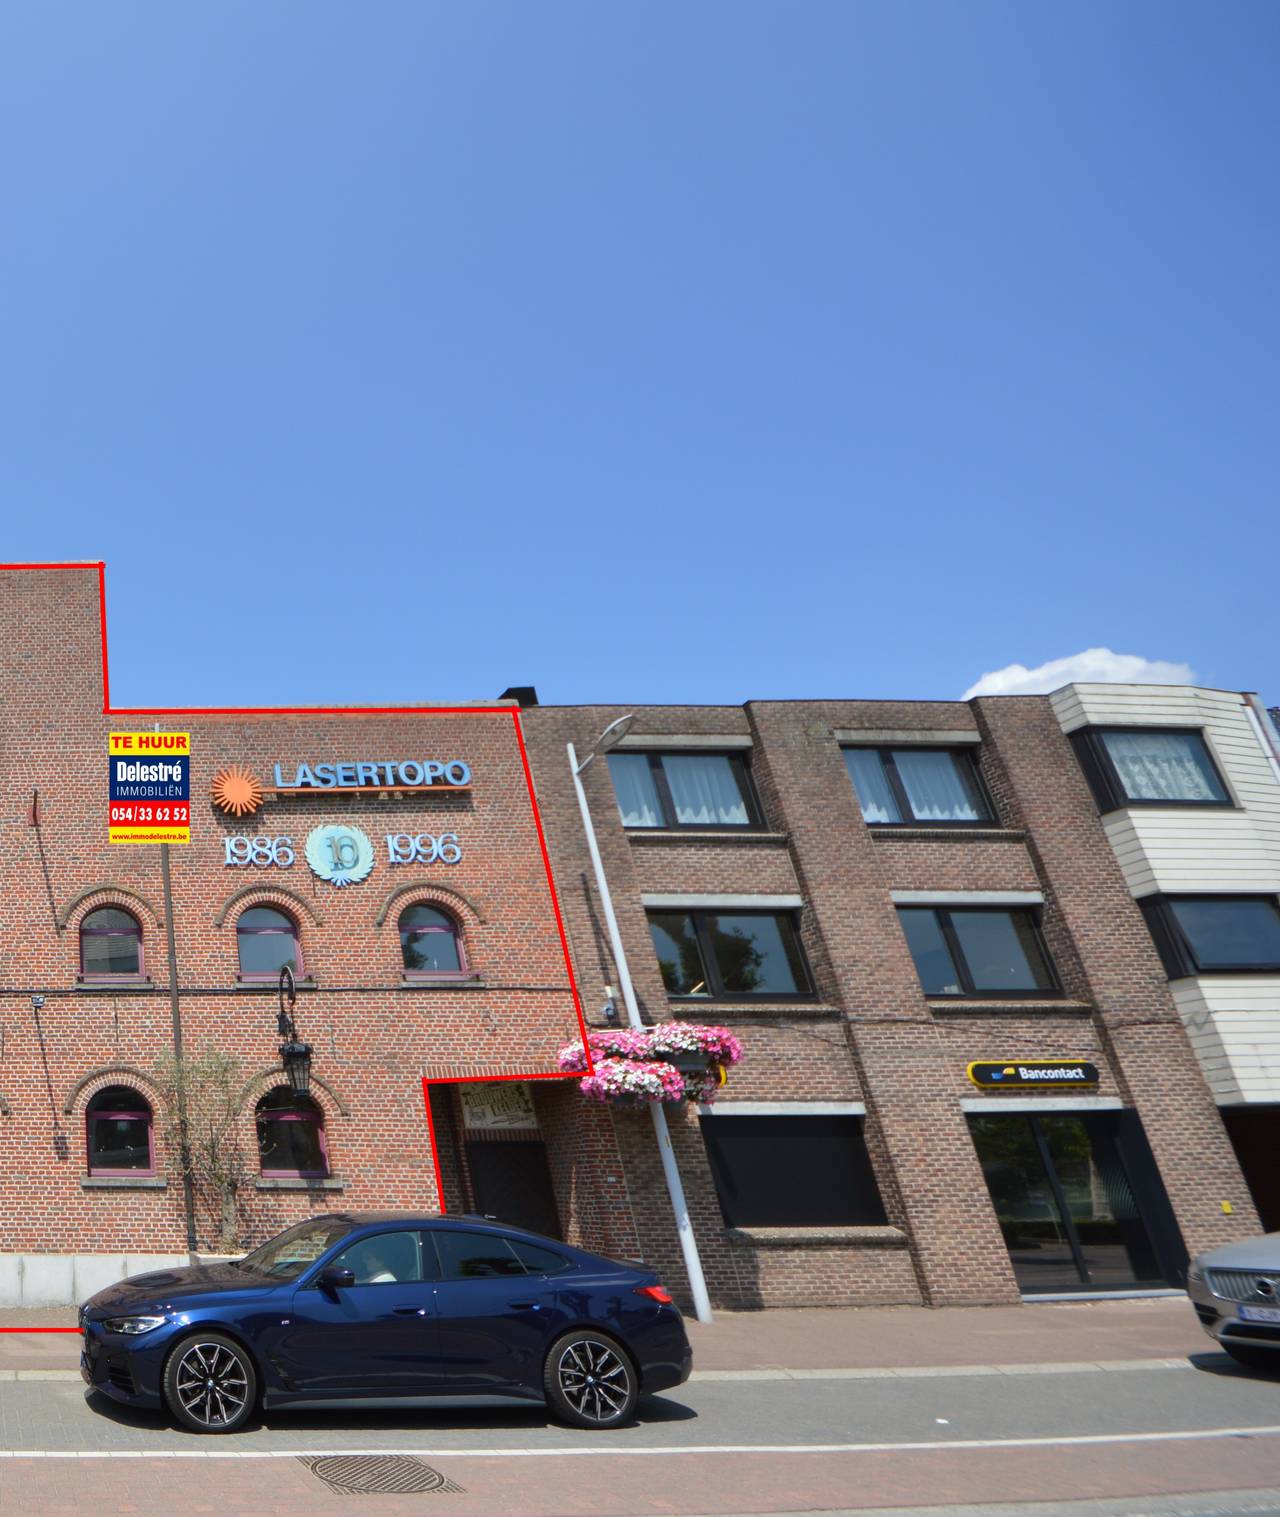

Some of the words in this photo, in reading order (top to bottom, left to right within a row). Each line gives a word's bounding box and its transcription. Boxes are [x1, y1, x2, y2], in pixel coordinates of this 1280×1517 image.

[111, 736, 133, 749] TE
[138, 736, 187, 749] HUUR
[116, 760, 182, 782] Delestré
[274, 760, 471, 788] LASERTOPO
[116, 784, 182, 797] IMMOBILIËN
[111, 805, 153, 822] 054/33
[155, 807, 170, 821] 62
[173, 807, 187, 821] 52
[111, 833, 187, 841] www.immodelestre.be
[222, 836, 296, 867] 1986
[386, 832, 463, 865] 1996
[1018, 1067, 1086, 1080] Bancontact
